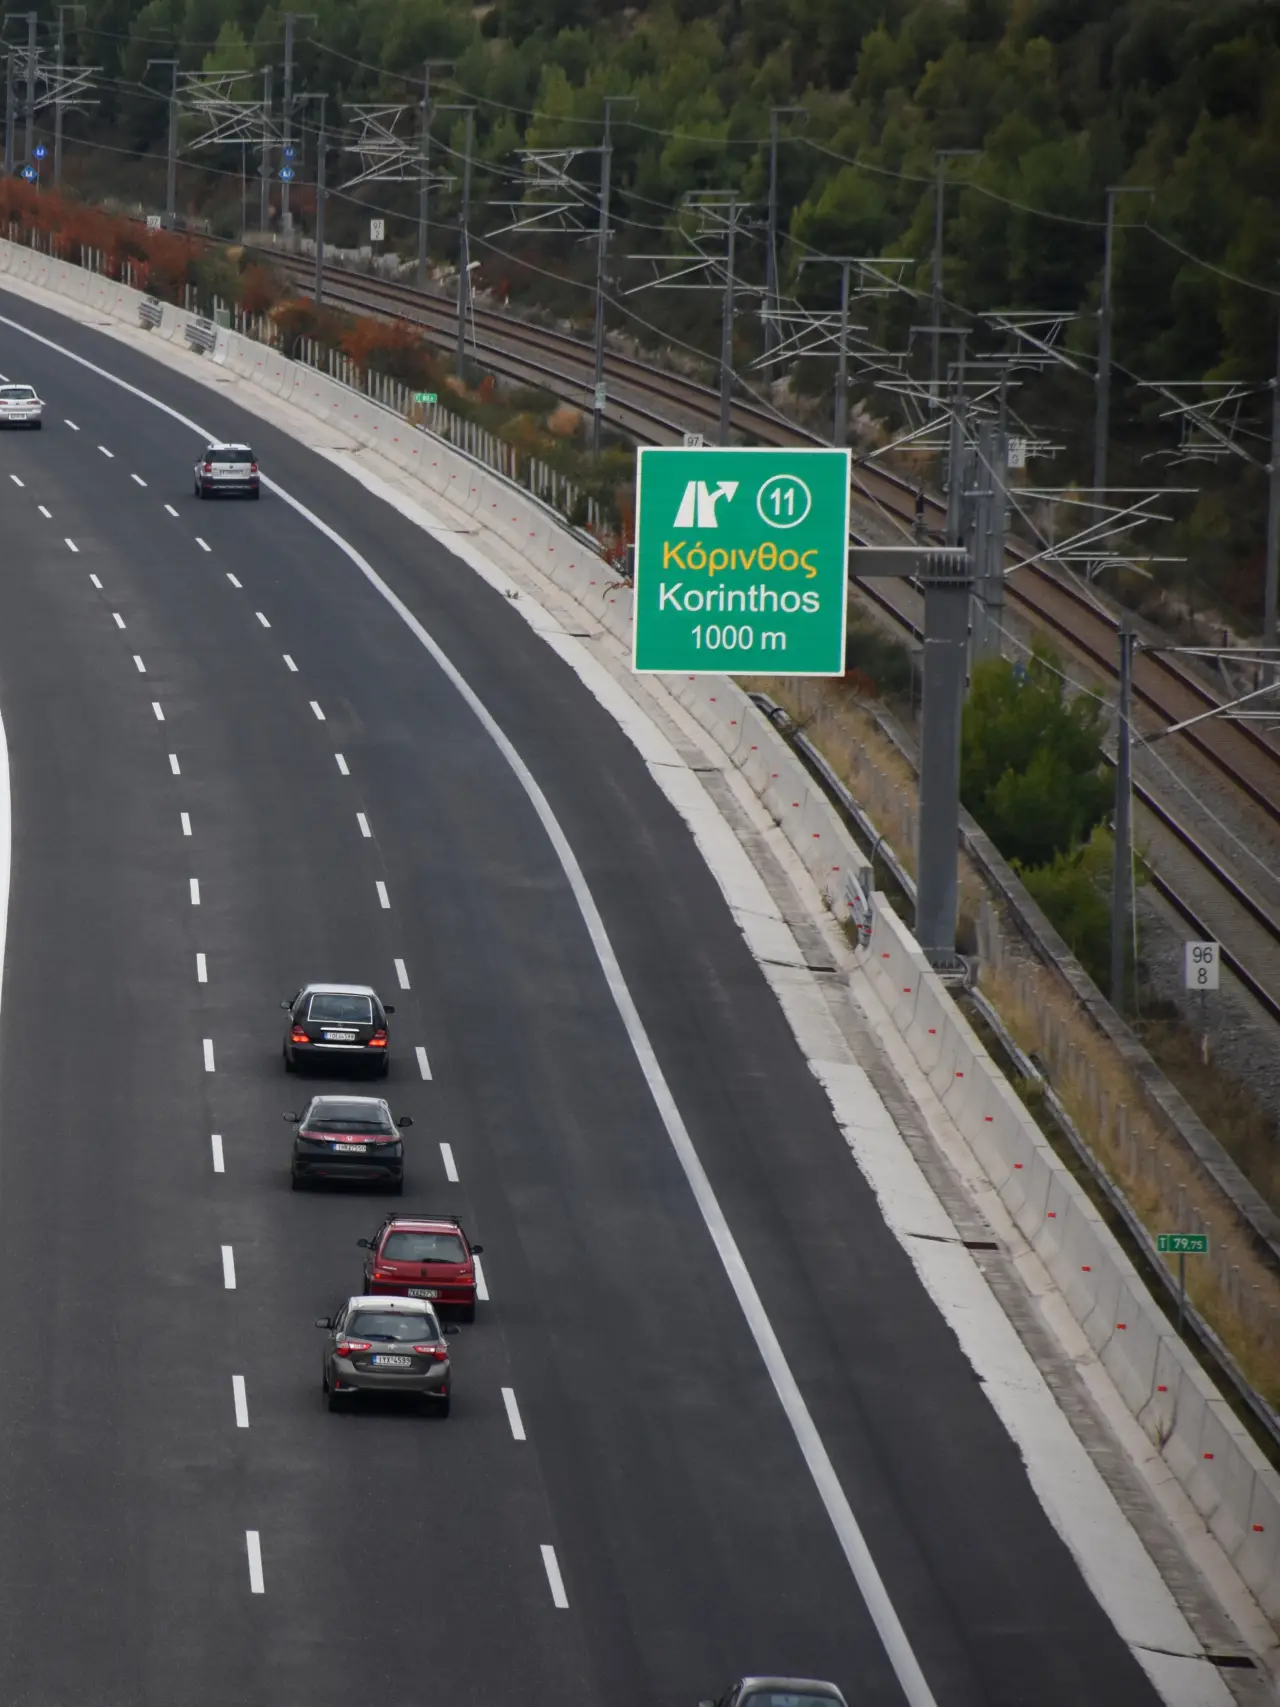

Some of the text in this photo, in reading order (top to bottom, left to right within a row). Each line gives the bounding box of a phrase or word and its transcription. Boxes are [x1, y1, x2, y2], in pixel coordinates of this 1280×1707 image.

[687, 436, 698, 447] 97
[770, 487, 794, 516] 11
[662, 541, 818, 579] Κόρινθος
[659, 582, 820, 613] Korinthos
[691, 624, 786, 650] 1000 m
[1192, 946, 1213, 964] 96
[1197, 967, 1208, 985] 8
